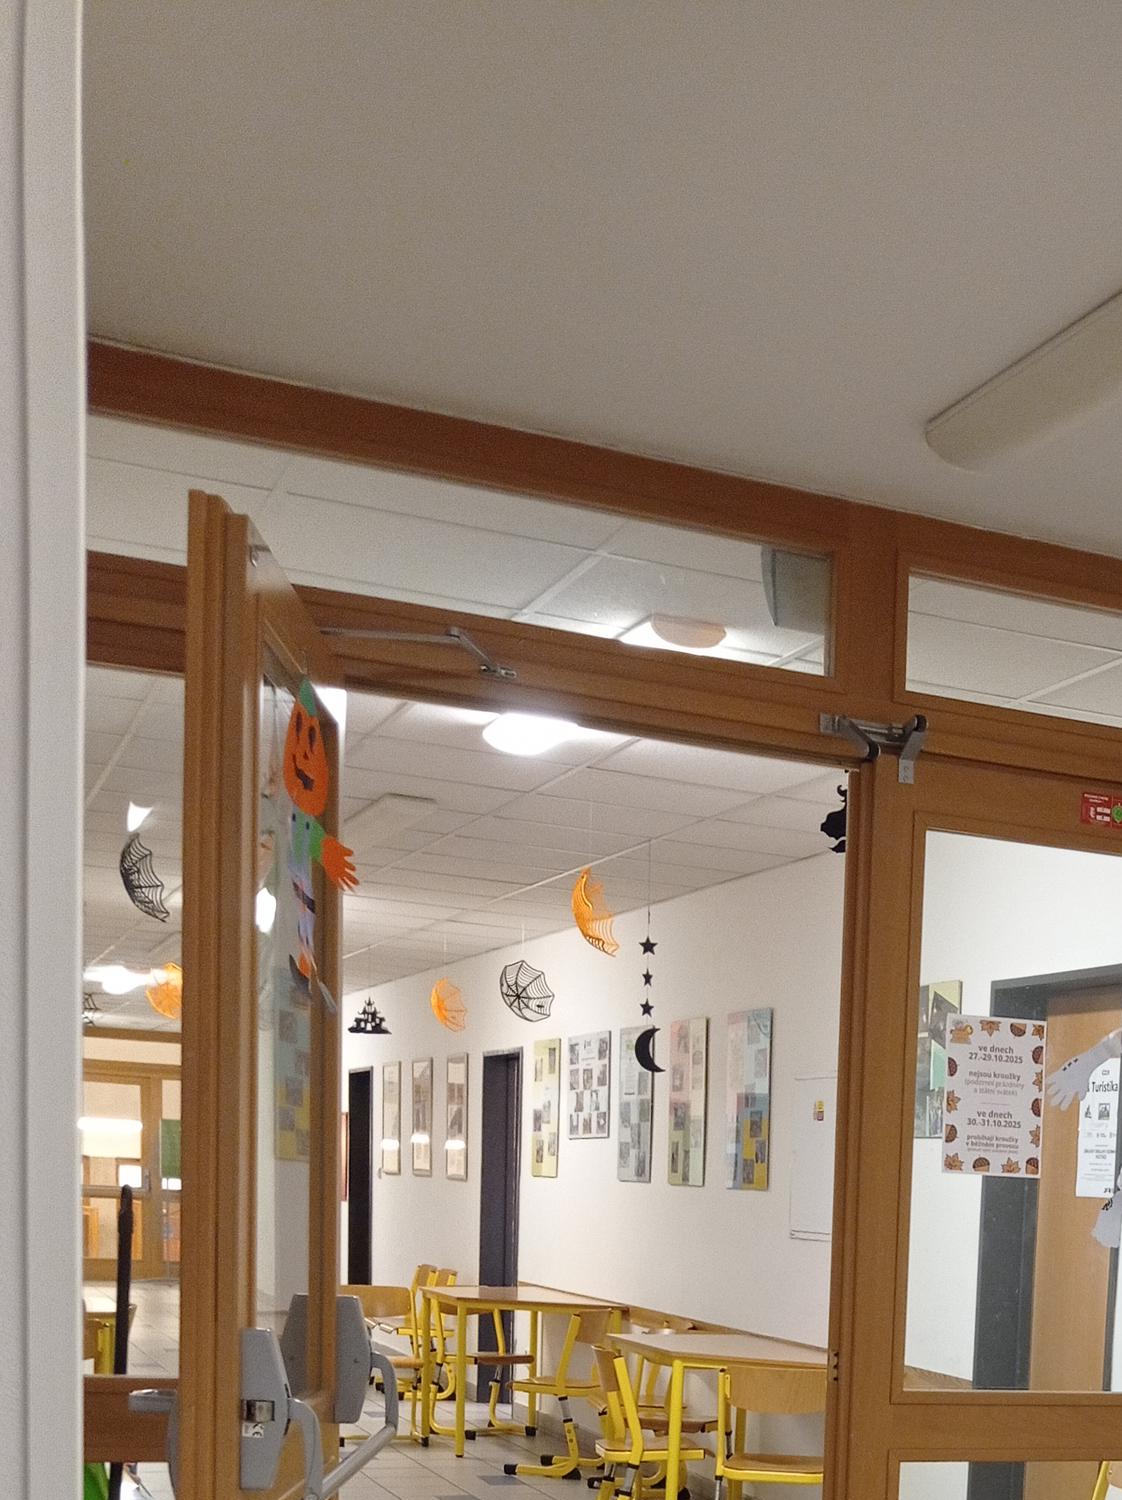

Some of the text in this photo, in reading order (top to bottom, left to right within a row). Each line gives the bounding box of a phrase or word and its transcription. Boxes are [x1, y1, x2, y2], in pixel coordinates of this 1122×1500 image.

[978, 1043, 1014, 1055] ve dnech
[968, 1051, 1023, 1064] 27.-29.10.2025
[968, 1070, 1021, 1082] nejsou kroužky
[1091, 1080, 1118, 1093] Turistika
[988, 1109, 1013, 1120] dnech
[967, 1117, 1021, 1129] 30.-31.10.2025
